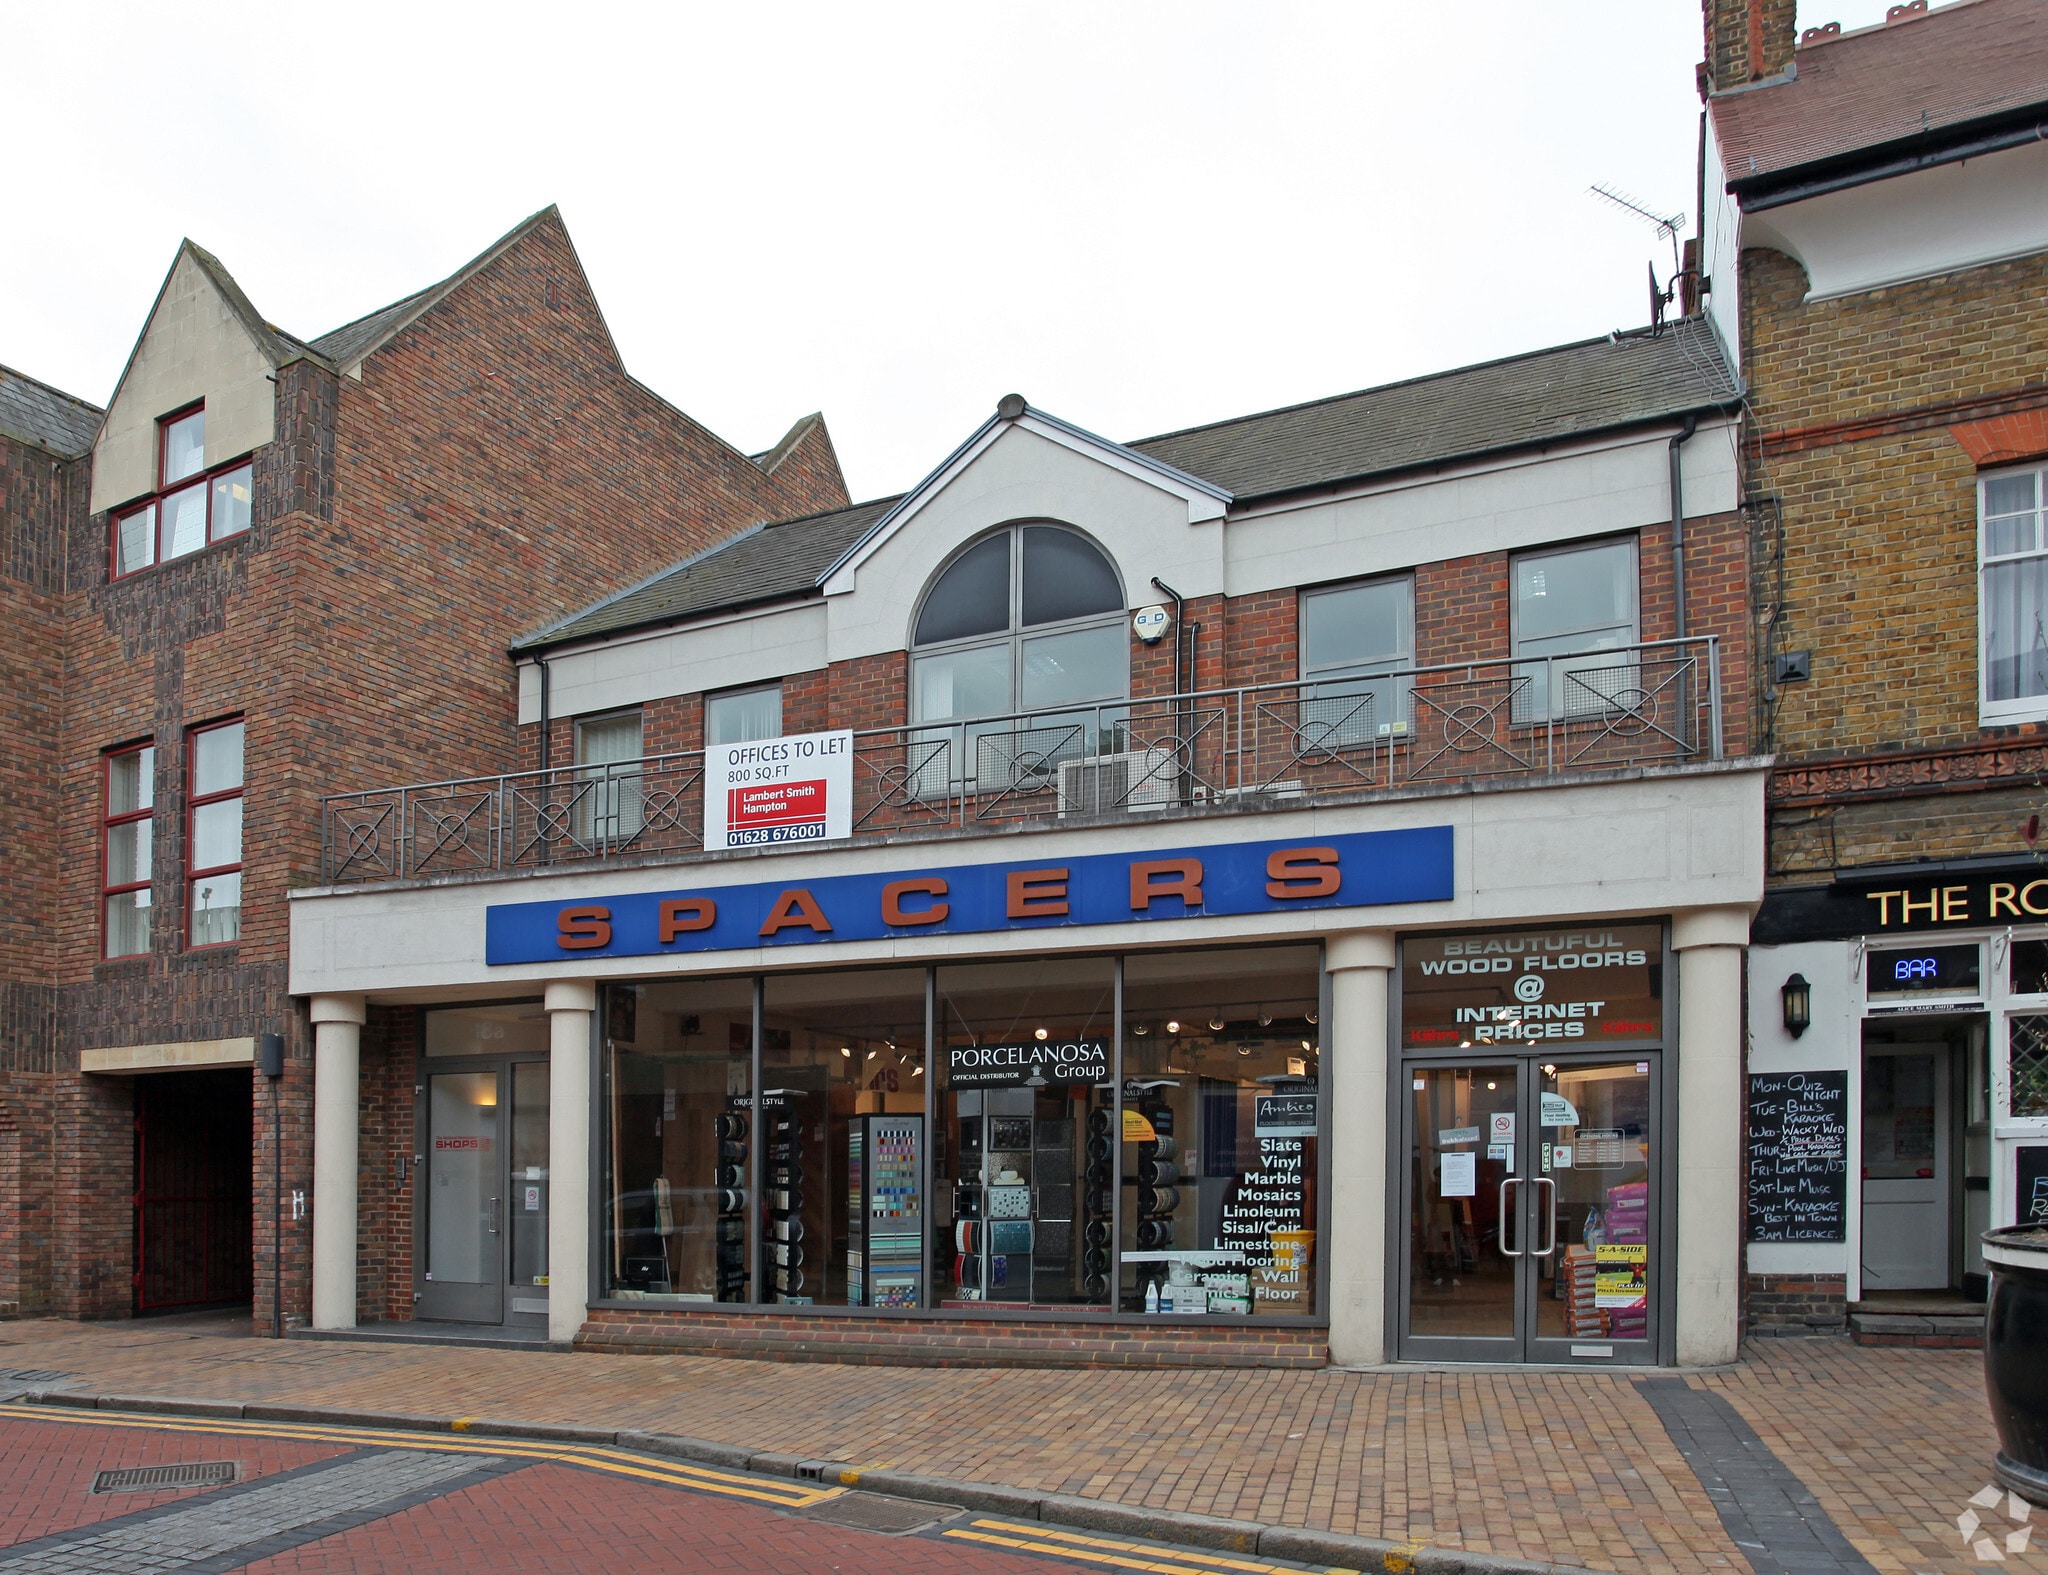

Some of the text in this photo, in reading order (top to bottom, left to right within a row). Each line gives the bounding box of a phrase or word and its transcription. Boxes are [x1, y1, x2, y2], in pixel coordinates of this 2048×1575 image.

[728, 737, 846, 765] OFFICES TO LET
[728, 765, 789, 782] 800 SQ.FT
[744, 786, 814, 802] Lambert Smith
[743, 801, 787, 814] Hampton
[729, 824, 823, 844] 01628 676001
[556, 847, 1341, 949] SPACERS
[1866, 885, 1969, 925] THE
[1444, 932, 1624, 956] BEAUTUFUL
[1420, 950, 1647, 976] WOOD FLOORS
[1895, 958, 1936, 980] BAR
[1514, 974, 1545, 1002] @
[1456, 1001, 1606, 1023] INTERNET
[1475, 1022, 1584, 1040] PRICES
[951, 1044, 1105, 1067] PORCELANOSA
[980, 1072, 1020, 1080] DISTRIBUTOR
[1054, 1064, 1105, 1080] Group
[1804, 1090, 1841, 1100] NIGHT
[1260, 1100, 1314, 1116] Amtico
[1784, 1113, 1834, 1124] KARAOKE
[1823, 1123, 1844, 1134] WED
[436, 1140, 478, 1148] SHOPS
[1260, 1139, 1302, 1152] Slate
[1260, 1156, 1301, 1170] Vinyl
[1244, 1172, 1301, 1184] Marble
[1238, 1188, 1301, 1201] Mosaics
[1224, 1205, 1300, 1218] Linoleum
[1764, 1212, 1837, 1223] BEST IN TOWN
[1222, 1221, 1301, 1234] Sisal/Coir
[1755, 1226, 1782, 1240] 3AM
[1214, 1238, 1300, 1250] Limestone
[1232, 1254, 1300, 1270] Flooring
[1261, 1270, 1300, 1283] Wall
[1255, 1286, 1299, 1299] Floor
